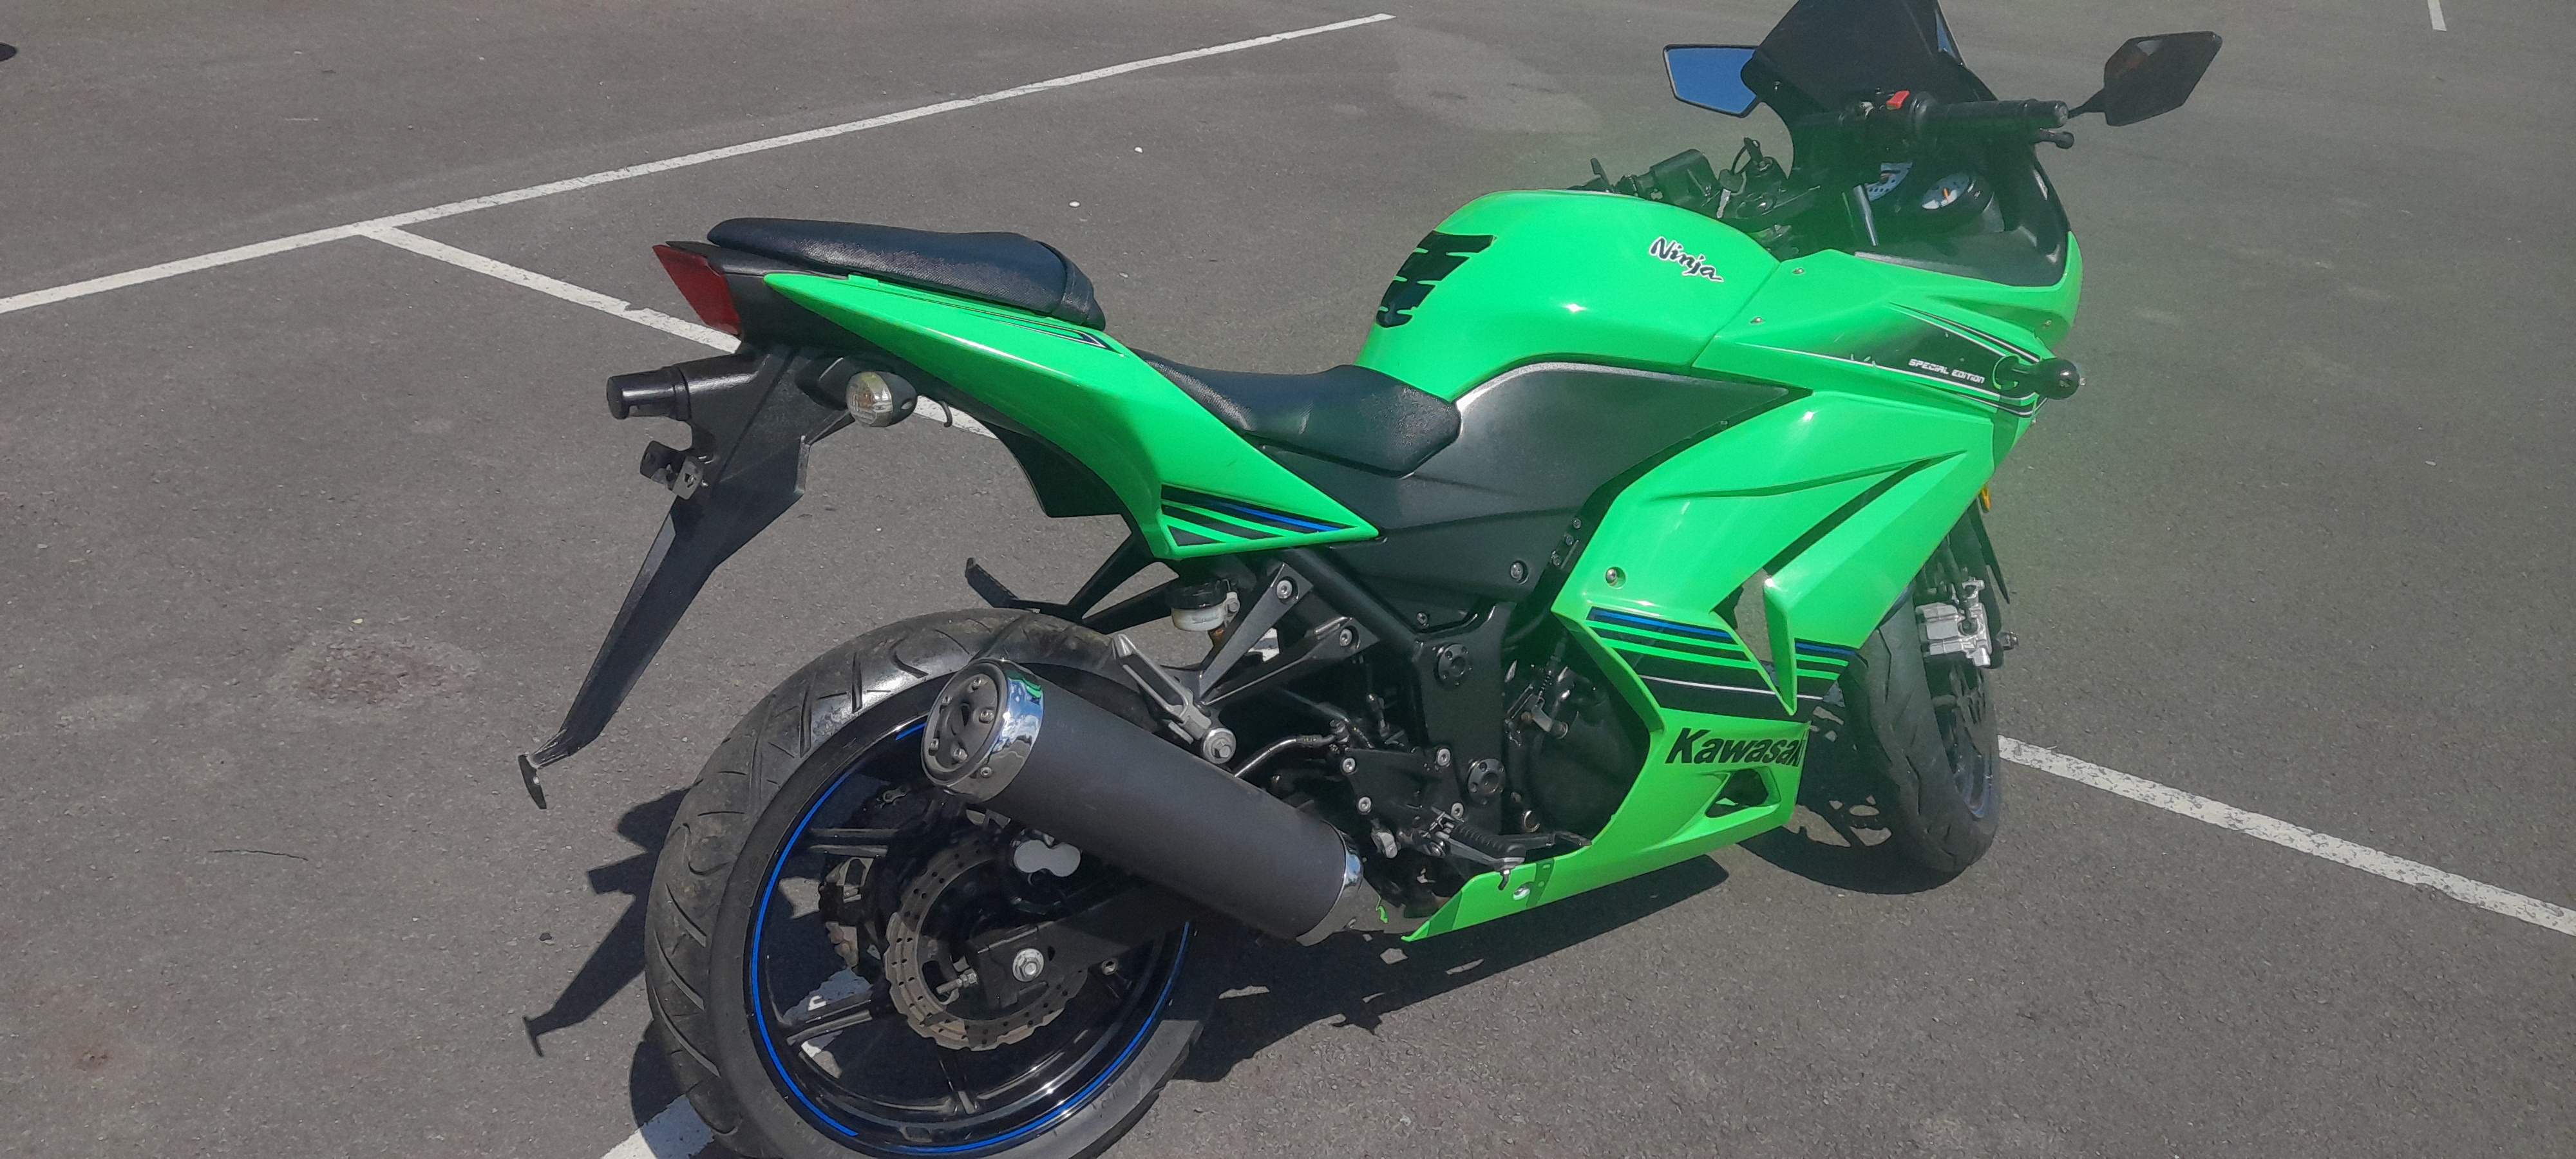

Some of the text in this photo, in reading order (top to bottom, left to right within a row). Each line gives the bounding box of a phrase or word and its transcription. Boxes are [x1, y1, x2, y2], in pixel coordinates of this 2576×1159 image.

[1649, 236, 1724, 282] Ninja
[1908, 358, 1985, 384] SPECIAL EDITION
